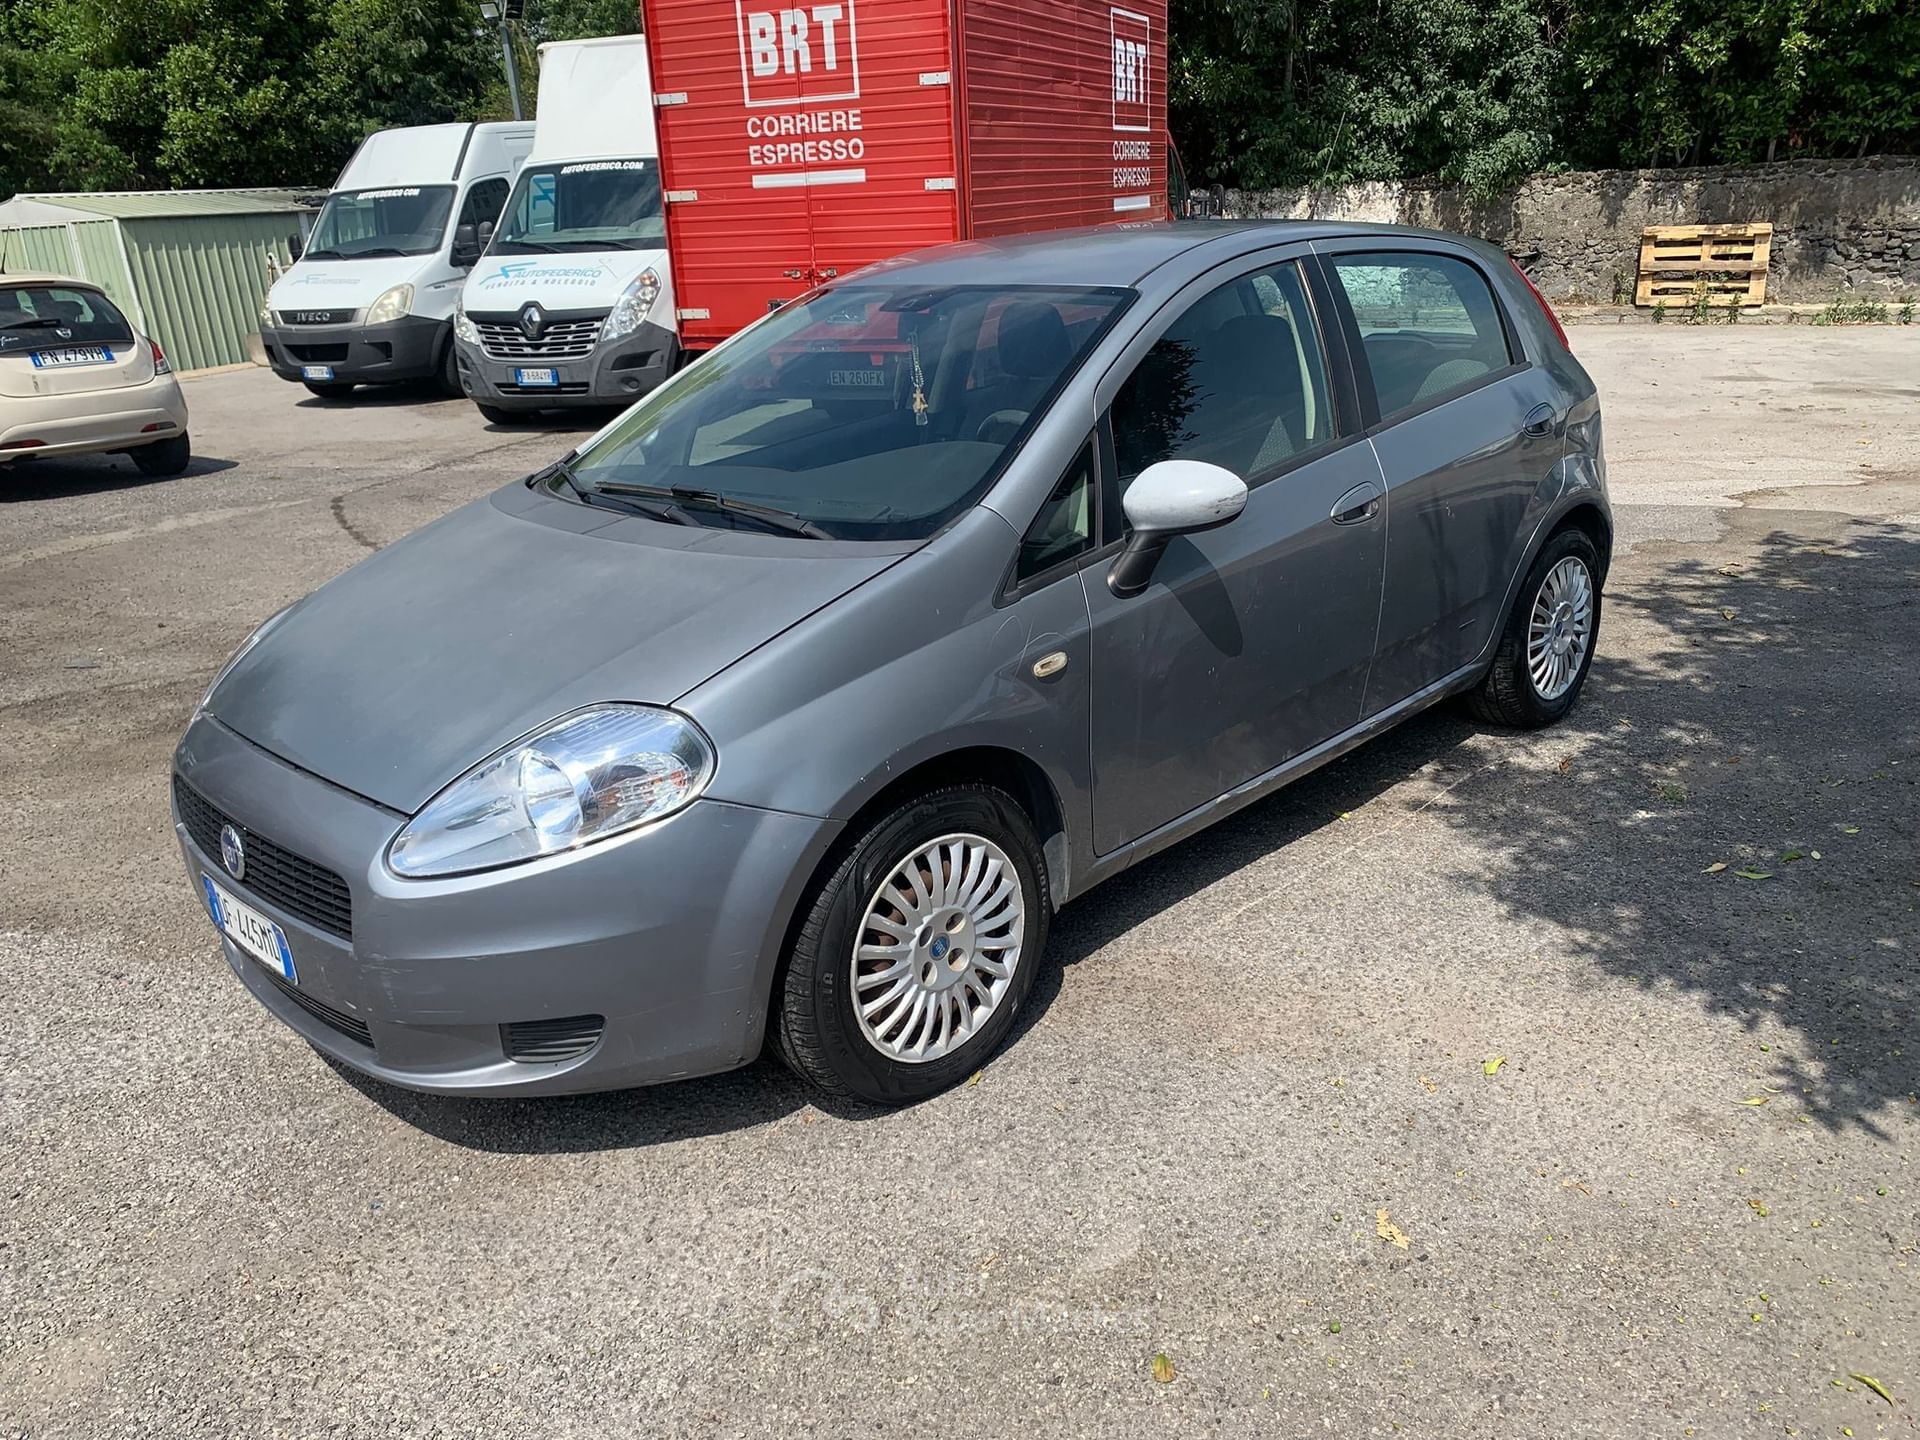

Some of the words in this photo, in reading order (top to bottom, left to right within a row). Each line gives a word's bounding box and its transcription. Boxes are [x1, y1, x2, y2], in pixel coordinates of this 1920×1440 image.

[748, 4, 843, 77] BRT
[1114, 38, 1147, 104] BRT
[746, 109, 863, 138] CORRIERE
[749, 137, 864, 166] ESPRESSO
[1112, 140, 1151, 161] CORRIERE
[561, 161, 644, 175] AUTOFEDERICO.COM
[1113, 167, 1151, 188] ESPRESSO
[296, 311, 331, 322] IVECO
[831, 371, 846, 385] EN
